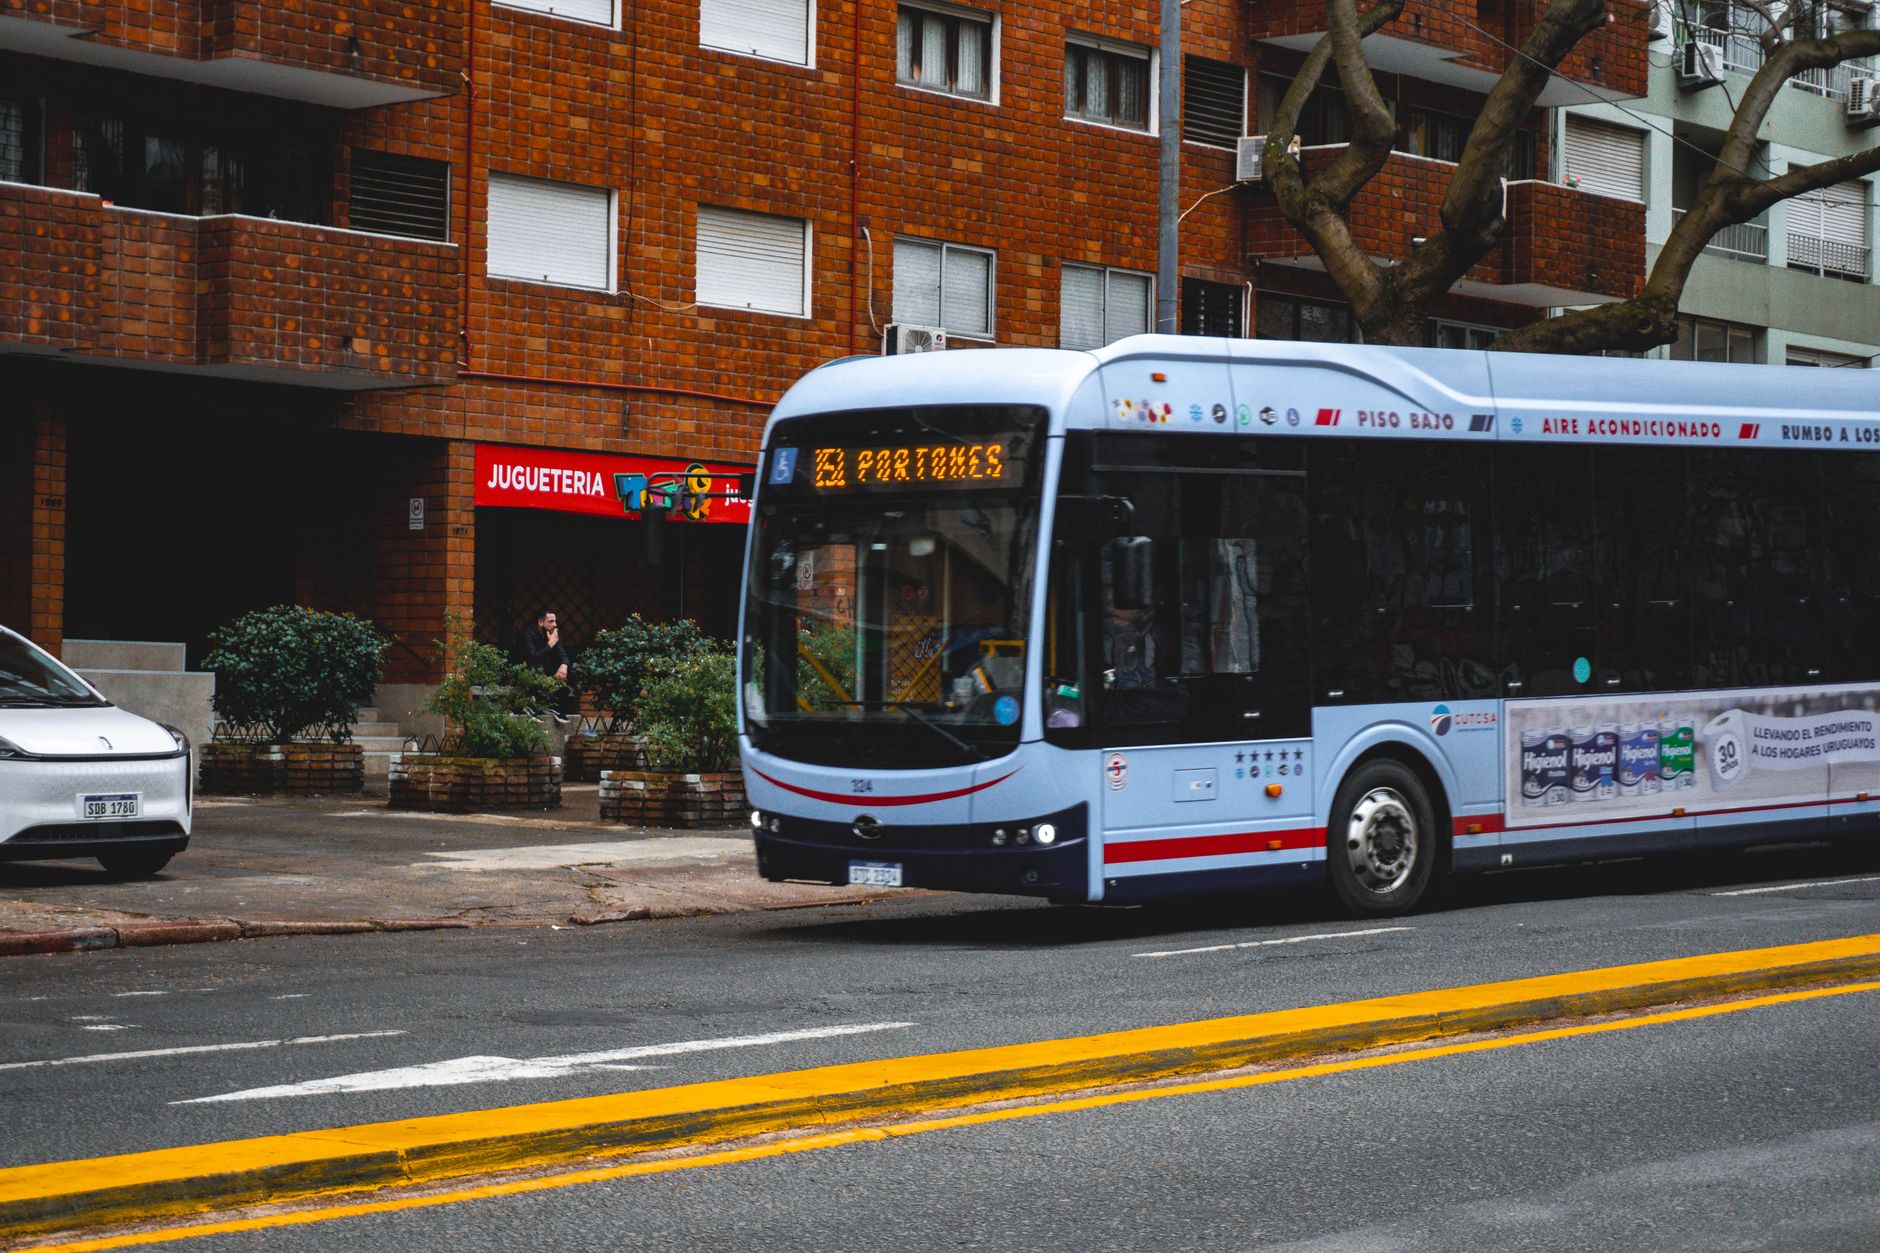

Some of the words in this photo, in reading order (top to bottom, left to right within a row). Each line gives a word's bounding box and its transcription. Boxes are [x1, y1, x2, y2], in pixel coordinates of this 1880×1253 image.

[1357, 409, 1400, 428] PISO
[1409, 410, 1455, 430] BAJO
[1542, 417, 1579, 434] AIRE
[1587, 418, 1721, 438] ACONDICIONADO
[1781, 424, 1833, 442] RUMBO
[1839, 426, 1849, 442] A
[1855, 427, 1880, 443] LOS
[857, 444, 1002, 482] PORTONES
[487, 463, 605, 496] JUGUETERIA
[1753, 726, 1800, 741] LLEVANDO
[1802, 728, 1813, 740] EL
[1814, 721, 1872, 738] RENDIMIENTO
[1571, 745, 1616, 771] Higienol
[1621, 743, 1658, 764] Higienol
[1718, 740, 1736, 763] 30
[1752, 744, 1759, 754] A
[1760, 746, 1778, 758] LOS
[1779, 743, 1822, 759] HOGARES
[1823, 738, 1876, 754] URUGUAYOS
[1523, 749, 1567, 774] Higienol
[88, 802, 107, 815] SDB
[110, 801, 135, 814] 1780
